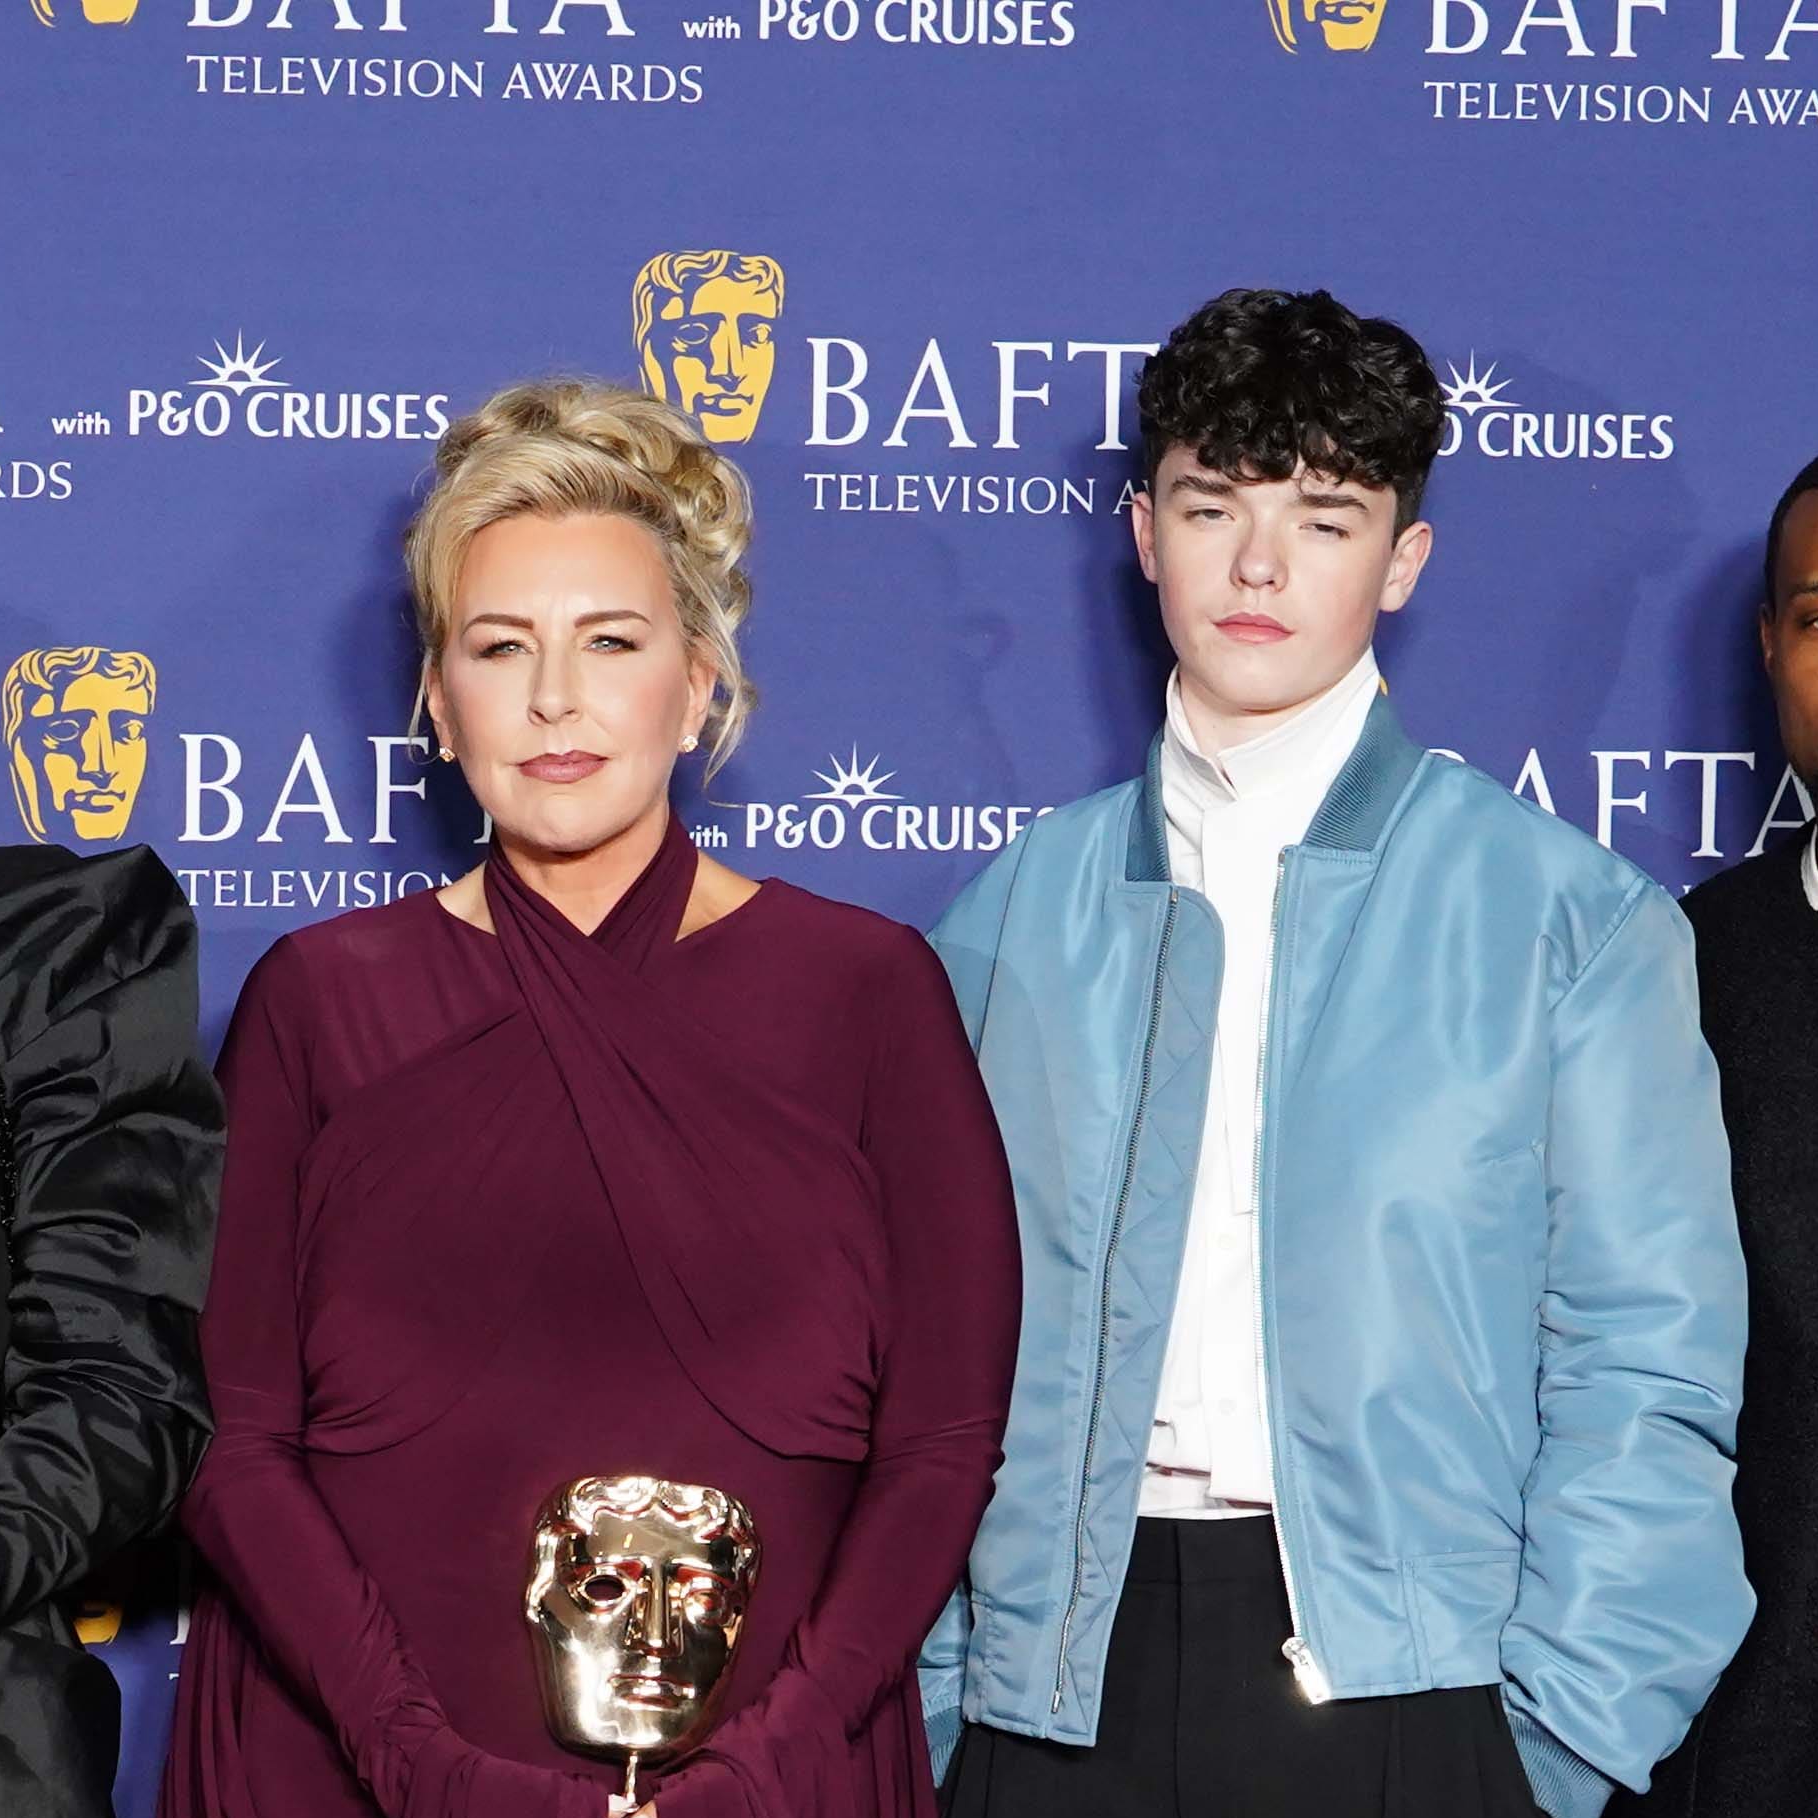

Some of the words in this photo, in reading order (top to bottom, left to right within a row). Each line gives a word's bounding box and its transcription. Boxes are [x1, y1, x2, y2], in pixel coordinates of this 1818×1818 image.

[682, 15, 741, 39] with
[759, 0, 860, 42] P&O
[874, 0, 1075, 47] CRUISES
[186, 55, 484, 98] TELEVISION
[502, 62, 703, 103] AWARDS
[1423, 81, 1712, 123] TELEVISION
[51, 411, 111, 435] with
[129, 391, 231, 437] P&O
[246, 394, 450, 440] CRUISES
[804, 337, 1161, 450] BAFT
[1477, 412, 1674, 460] CRUISES
[804, 473, 1095, 514] TELEVISION
[179, 733, 492, 843] BAF
[1427, 748, 1815, 858] FTA
[689, 824, 728, 848] ith
[746, 803, 846, 849] P&O
[860, 804, 1054, 851] CRUISE
[178, 869, 455, 908] TELEVISIO
